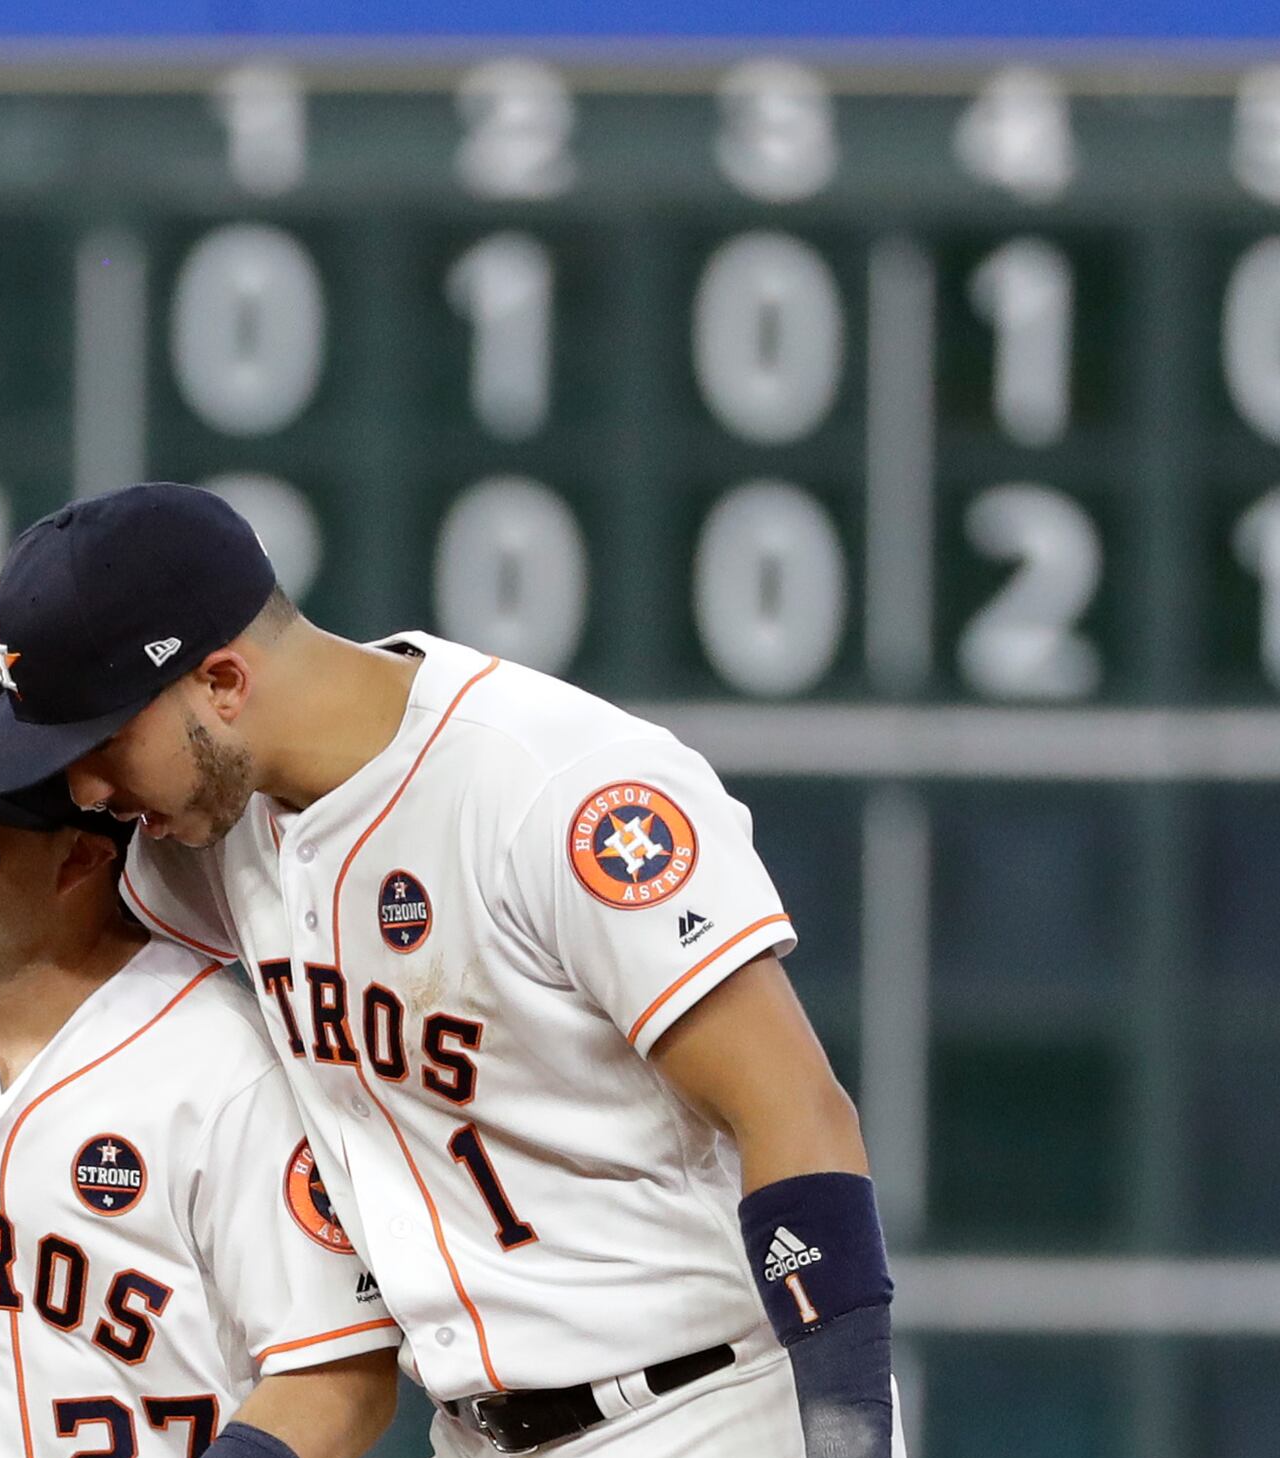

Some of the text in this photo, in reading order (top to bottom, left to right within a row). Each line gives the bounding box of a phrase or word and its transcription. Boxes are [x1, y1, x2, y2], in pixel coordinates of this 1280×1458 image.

[217, 60, 307, 198] 1
[456, 58, 578, 200] 2
[717, 58, 838, 200] 3
[953, 65, 1077, 202] 4
[170, 222, 324, 436] 0
[447, 232, 554, 440] 1
[692, 230, 845, 445] 0
[970, 238, 1074, 447] 1
[434, 475, 587, 688] 0
[694, 480, 847, 698] 0
[958, 484, 1103, 702] 2
[575, 788, 651, 852] HOUSTON
[604, 816, 663, 875] H
[623, 846, 692, 901] ASTROS
[382, 902, 427, 922] STRONG
[257, 957, 483, 1106] TROS
[77, 1165, 140, 1187] STRONG
[447, 1123, 539, 1252] 1
[764, 1247, 822, 1281] adidas
[784, 1272, 819, 1323] 1
